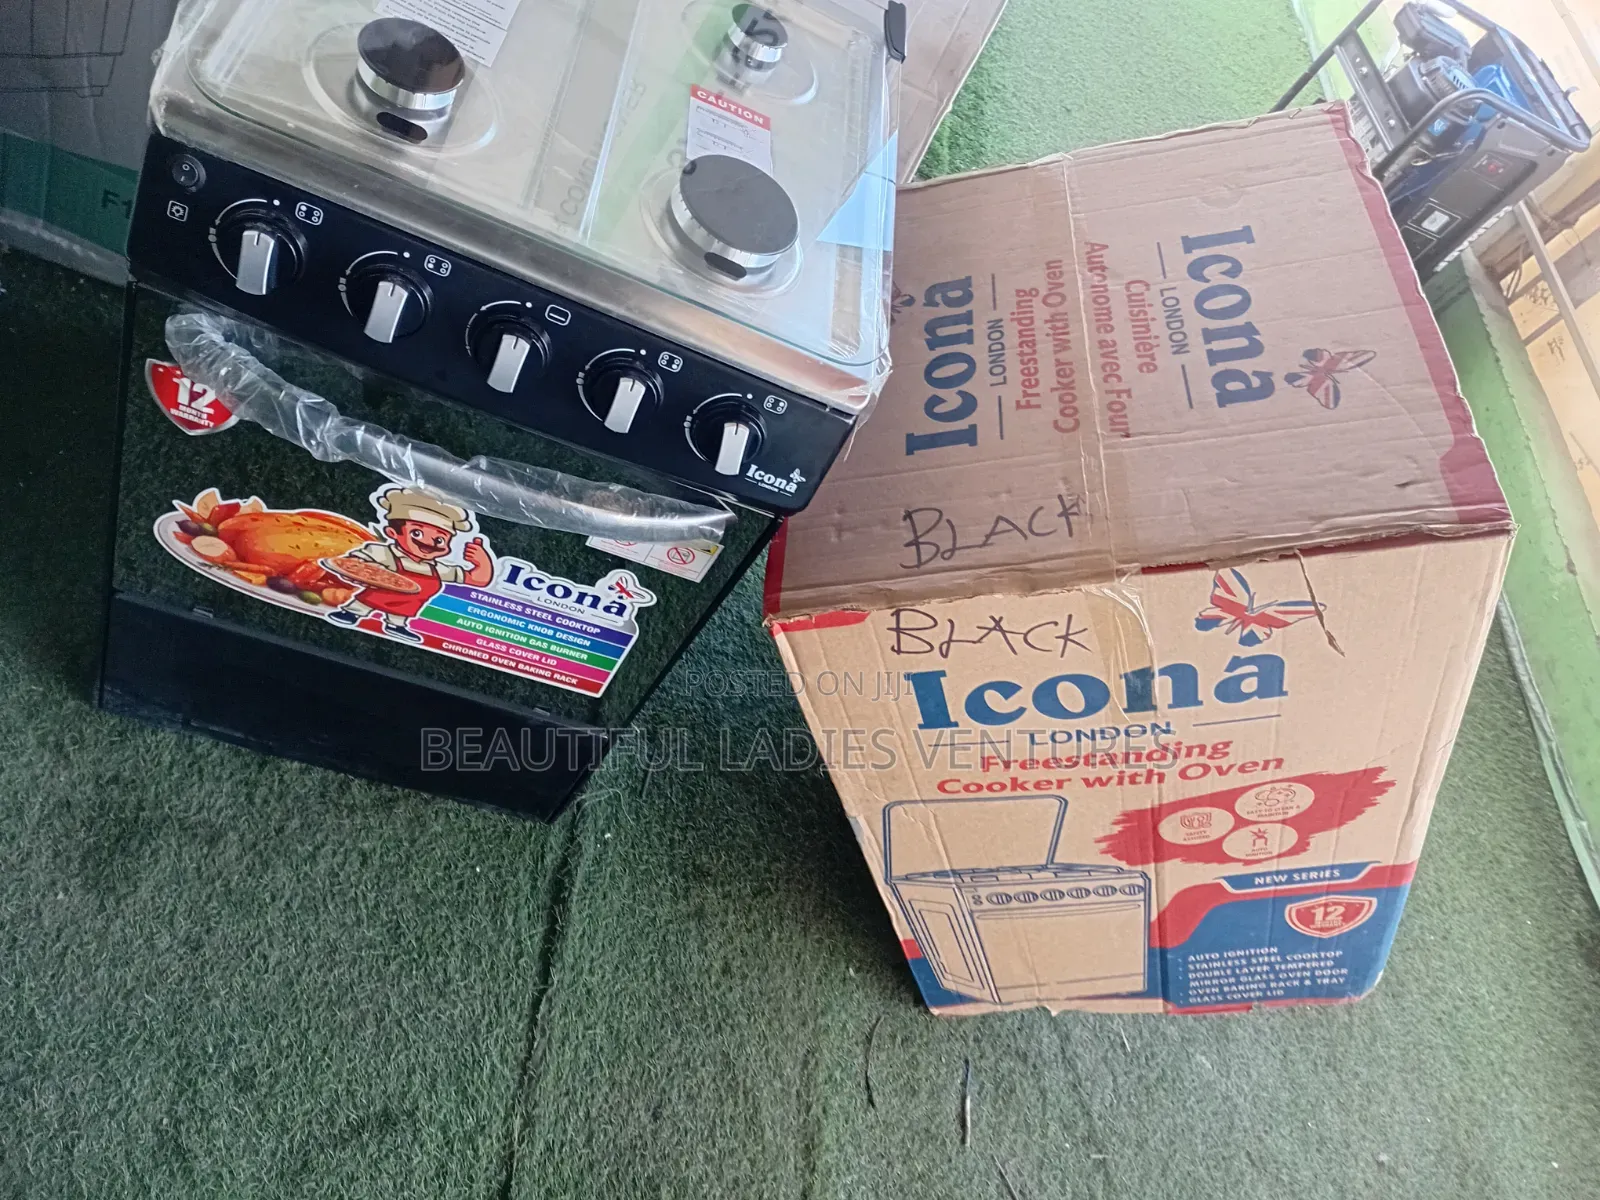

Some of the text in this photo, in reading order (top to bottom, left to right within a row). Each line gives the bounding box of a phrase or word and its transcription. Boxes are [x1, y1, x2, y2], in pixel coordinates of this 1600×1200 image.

[696, 90, 765, 125] CAUTION
[1124, 279, 1161, 374] Cuisinière
[1159, 286, 1191, 356] LONDON
[1180, 225, 1276, 408] Icona
[987, 318, 1008, 387] LONDON
[1010, 287, 1042, 411] Freestanding
[1042, 259, 1081, 433] Cooker with Oven
[1084, 241, 1133, 439] Autonome avec Four
[906, 275, 978, 456] Icona
[172, 377, 216, 415] 12
[746, 463, 798, 494] Icona
[899, 493, 1083, 570] BLACK
[503, 563, 628, 618] Icona
[536, 596, 586, 615] LONDON
[467, 605, 591, 647] ERGONOMIC KNOB DESIGN
[470, 591, 601, 635] STAINLESS STEEL COOKTOP
[887, 607, 1093, 660] BLACK
[456, 618, 589, 661] AUTO IGNITION GAS BURNER
[476, 638, 557, 666] GLASS COVER LID
[442, 641, 578, 685] CHROMED OVEN BAKING RACK
[903, 650, 1289, 731] Icona
[1029, 721, 1172, 746] LONDON
[936, 755, 1286, 795] Cooker with Oven
[981, 738, 1234, 774] Freestanding
[1254, 869, 1341, 886] NEW SERIES
[1311, 905, 1346, 922] 12
[1188, 947, 1278, 962] AUTO IGNITION
[1188, 951, 1344, 970] STAINLESS STEEL COOKTOP
[1188, 960, 1335, 980] DOUBLE LAYER TEMPERED
[1189, 968, 1349, 988] MIRROR GLASS OVEN DOOR
[1189, 987, 1220, 996] OVEN
[1223, 983, 1267, 993] BAKING
[1270, 979, 1300, 989] RACK
[1316, 977, 1346, 985] TRAY
[1189, 989, 1285, 1004] GLASS COVER LID
